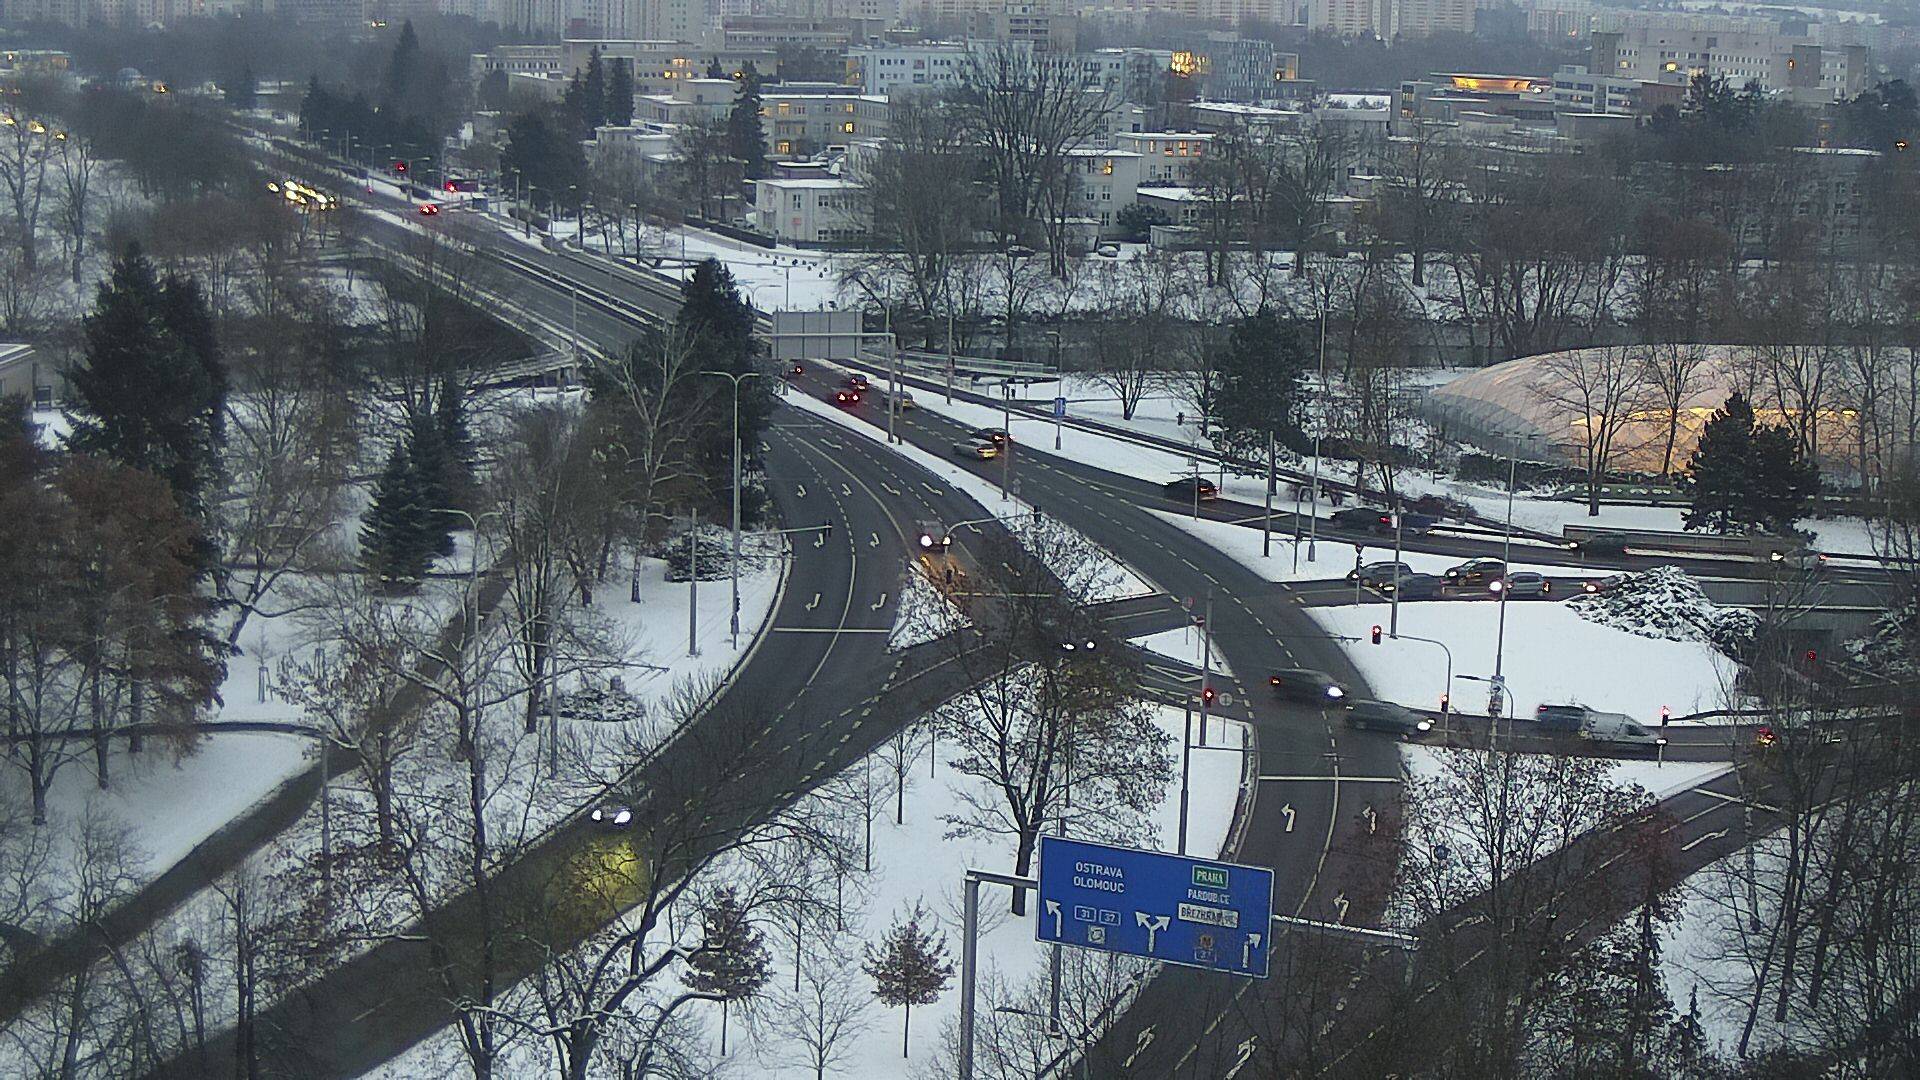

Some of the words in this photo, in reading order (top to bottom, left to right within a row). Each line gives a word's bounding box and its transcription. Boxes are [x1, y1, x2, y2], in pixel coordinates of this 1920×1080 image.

[1075, 861, 1123, 878] OSTRAVA
[1196, 870, 1223, 884] PRAHA
[1073, 876, 1125, 893] OLOMOUC
[1104, 913, 1116, 922] 37
